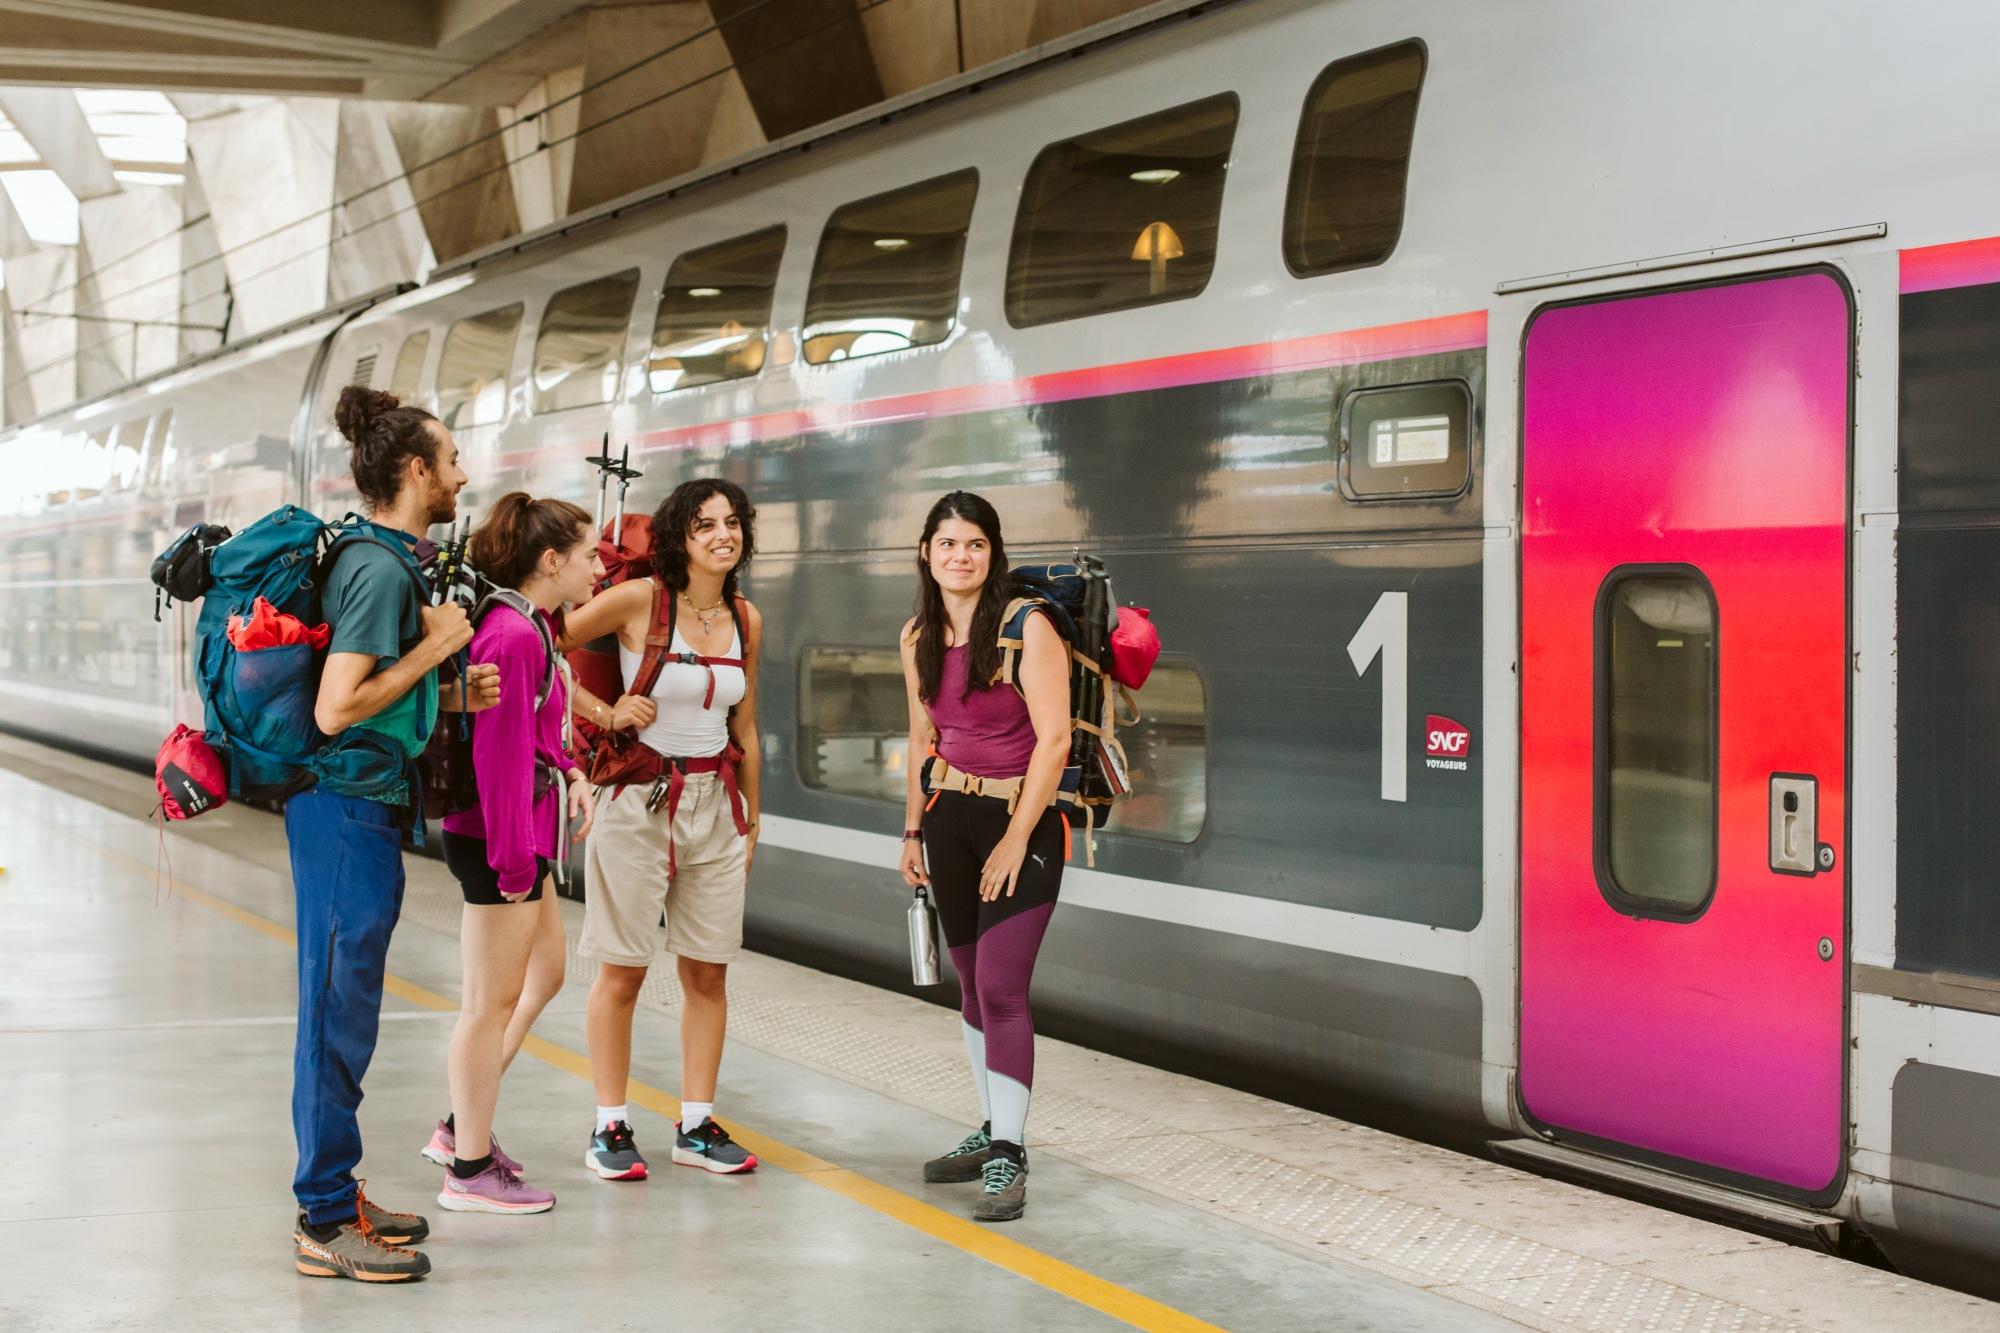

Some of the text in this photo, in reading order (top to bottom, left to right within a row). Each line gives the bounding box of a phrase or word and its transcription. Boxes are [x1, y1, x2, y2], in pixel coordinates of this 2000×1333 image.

[1346, 591, 1408, 802] 1
[1427, 730, 1468, 752] SNCF
[1426, 759, 1467, 771] VOYAGEURS
